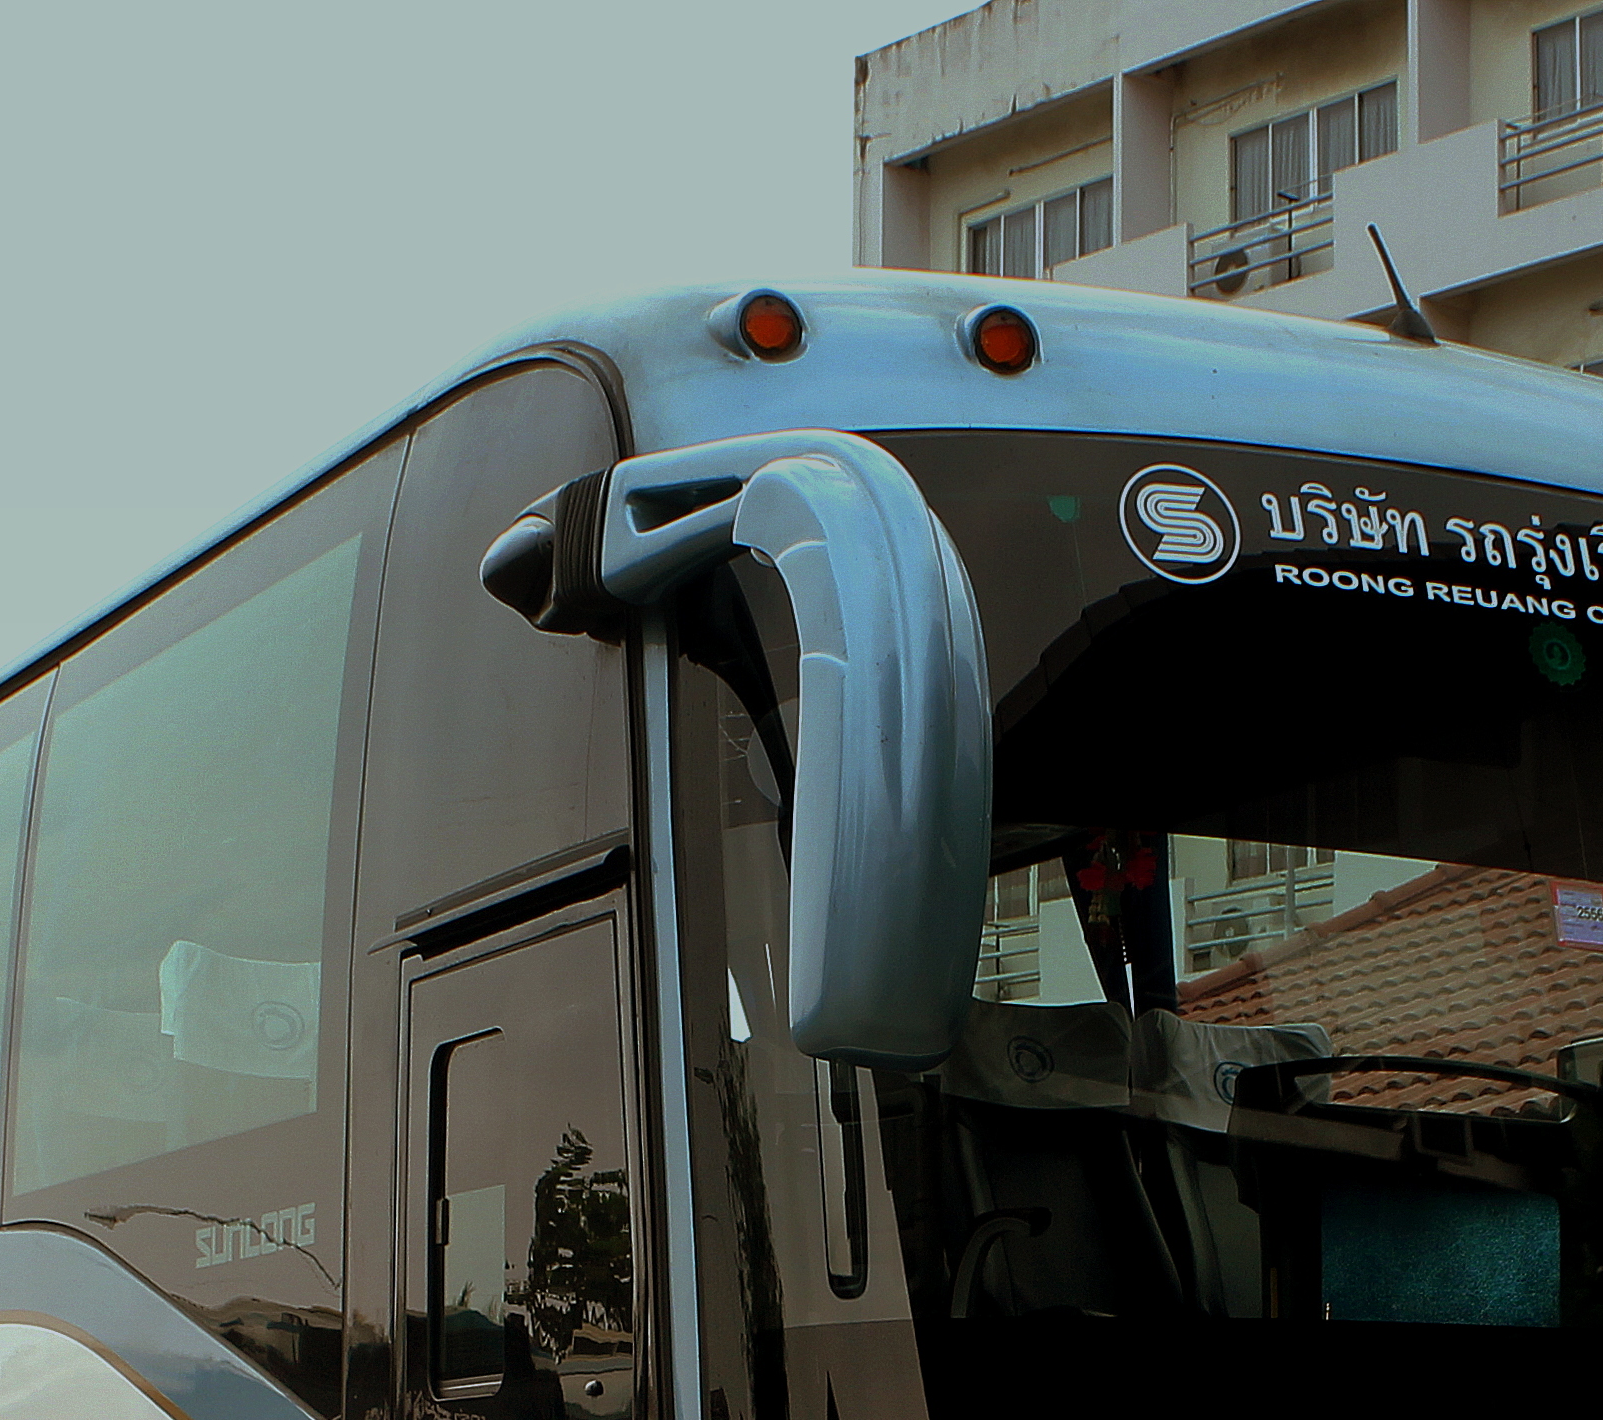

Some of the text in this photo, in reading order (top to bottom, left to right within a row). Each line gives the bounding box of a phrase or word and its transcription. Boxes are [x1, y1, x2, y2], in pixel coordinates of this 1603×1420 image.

[1260, 481, 1431, 558] บริษัท
[1274, 563, 1415, 599] ROONG
[1426, 581, 1577, 620] REUANG
[195, 1202, 317, 1269] SUNLONG
